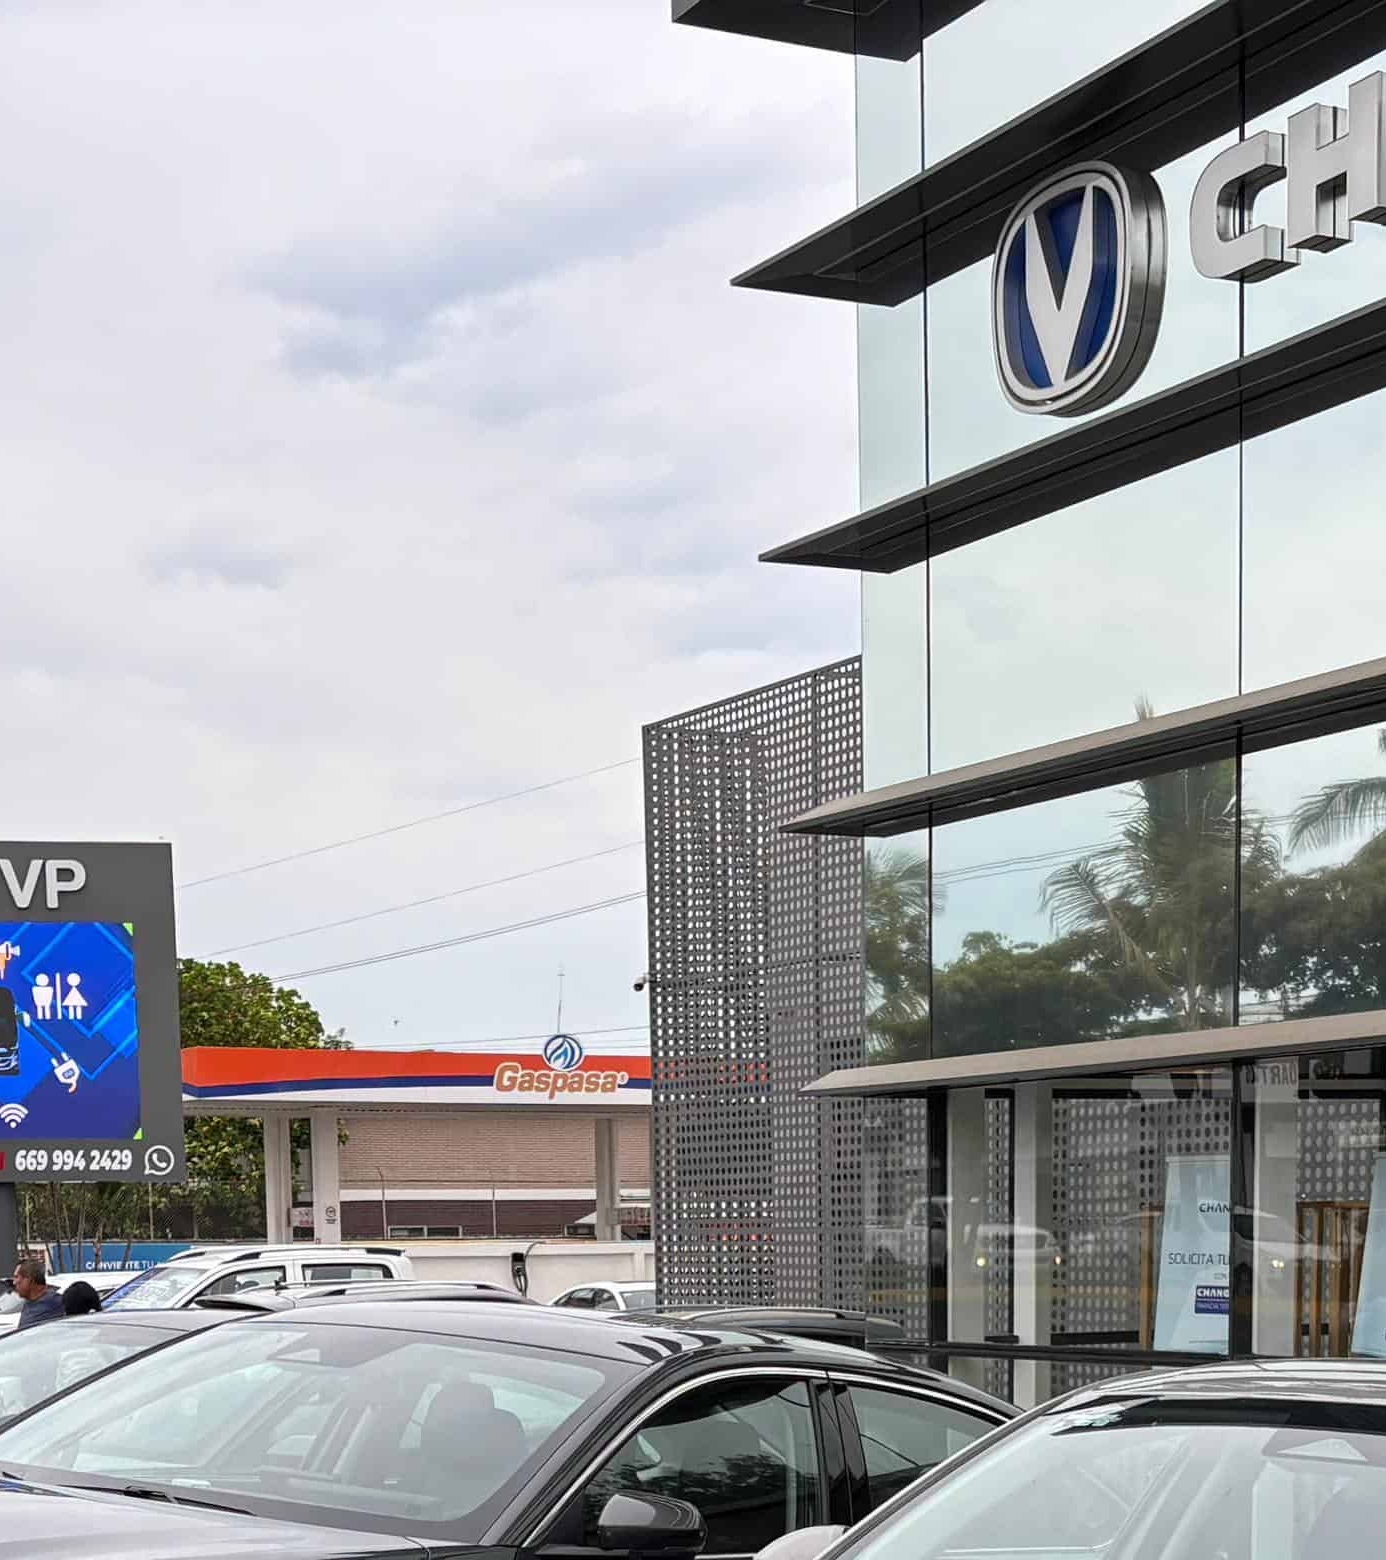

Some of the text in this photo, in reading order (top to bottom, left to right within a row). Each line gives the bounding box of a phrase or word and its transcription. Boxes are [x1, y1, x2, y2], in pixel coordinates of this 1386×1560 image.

[494, 1062, 619, 1101] Gaspasa
[15, 1149, 48, 1171] 669
[52, 1149, 86, 1171] 994
[89, 1149, 133, 1171] 2429
[1167, 1252, 1215, 1265] SOLICITA
